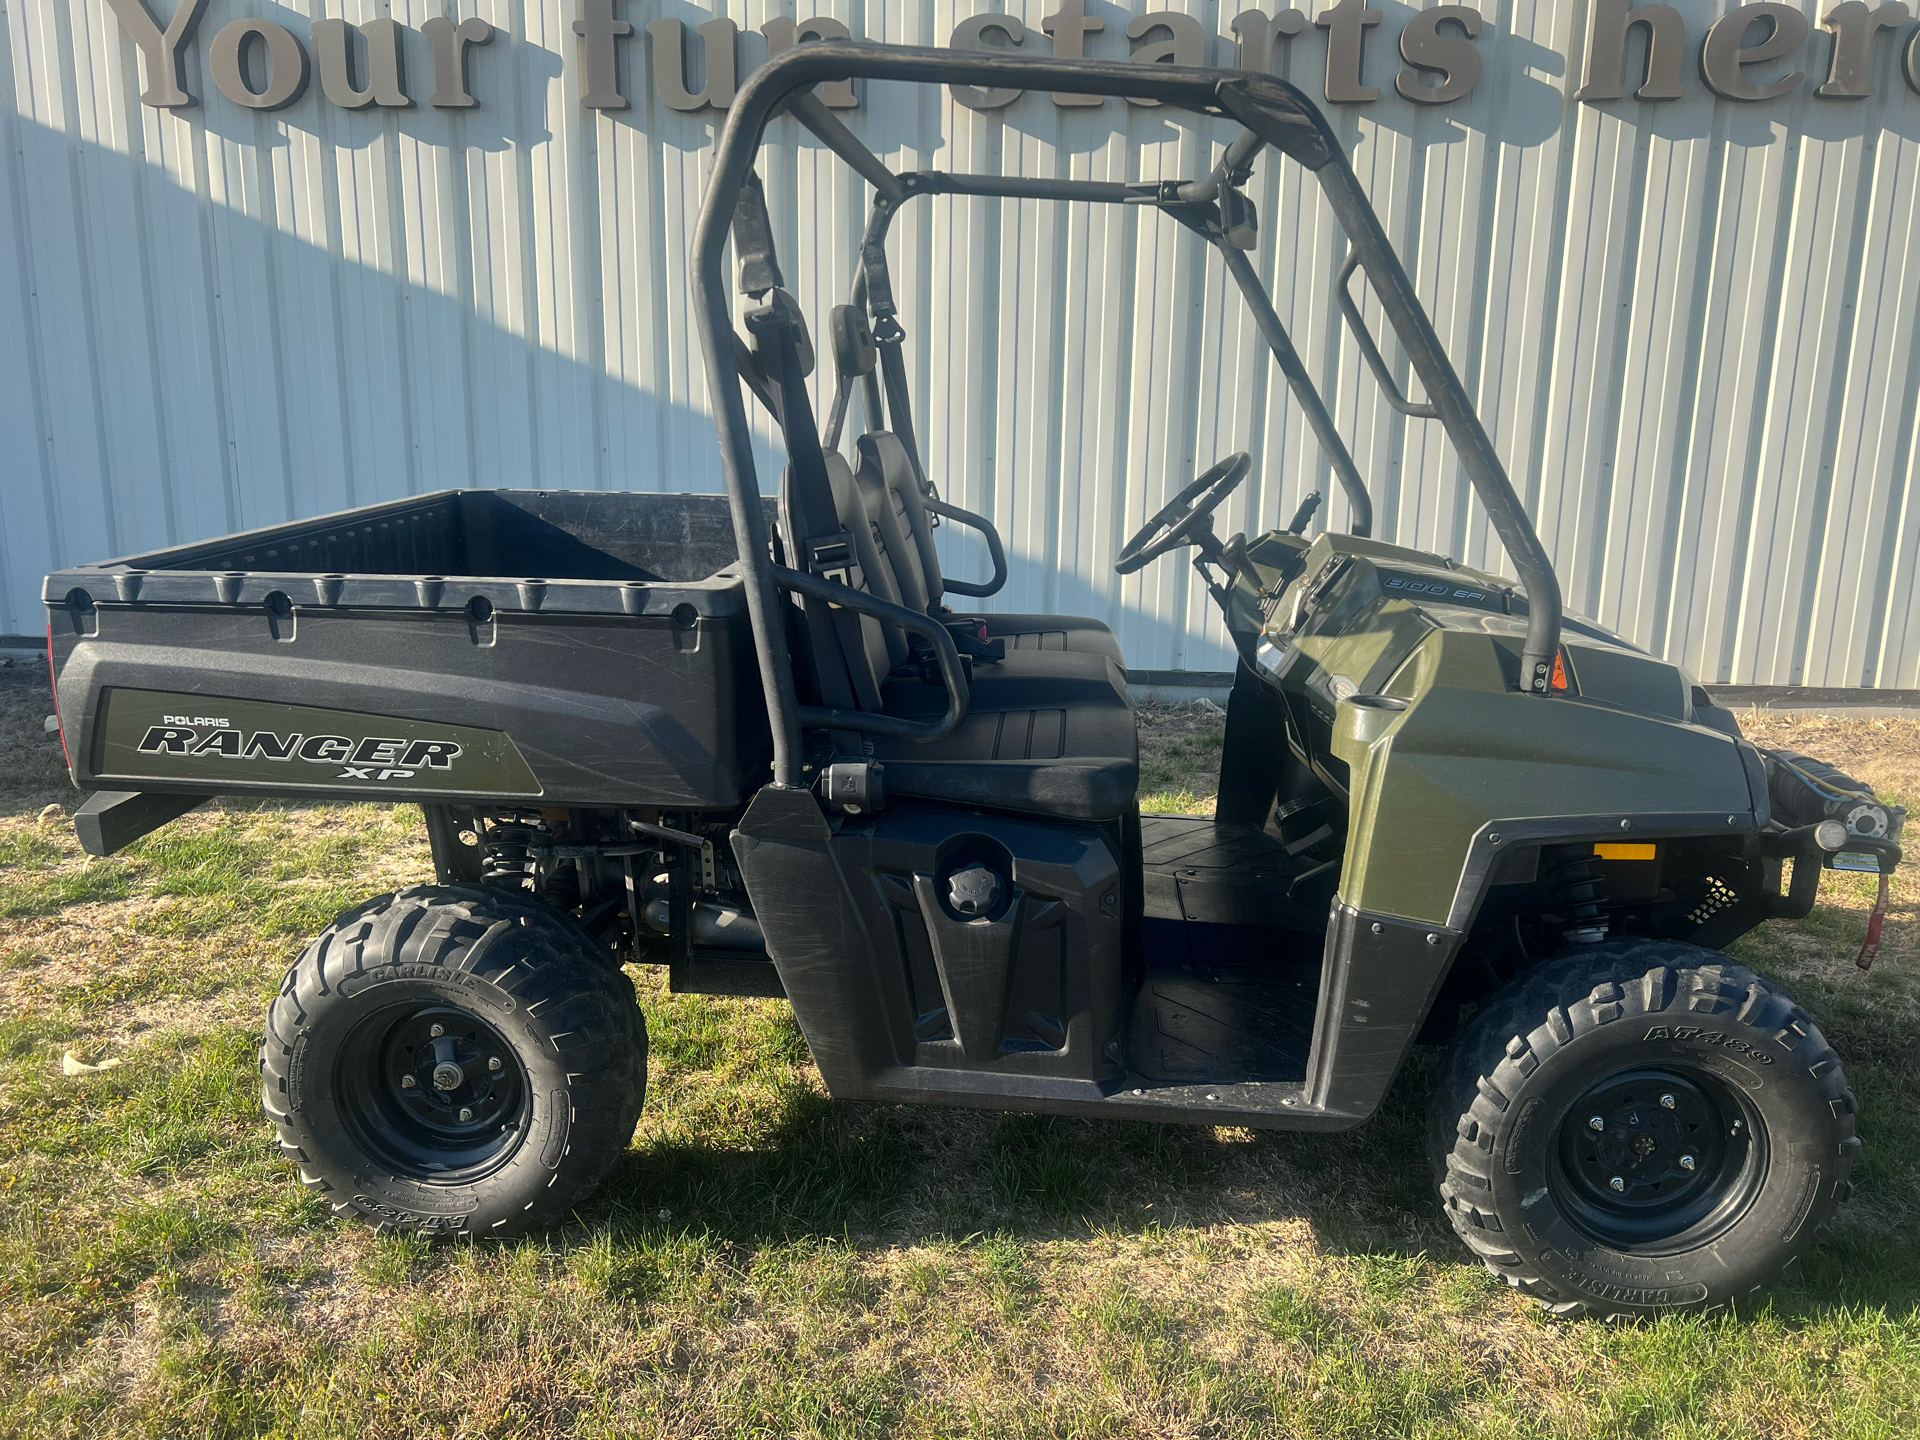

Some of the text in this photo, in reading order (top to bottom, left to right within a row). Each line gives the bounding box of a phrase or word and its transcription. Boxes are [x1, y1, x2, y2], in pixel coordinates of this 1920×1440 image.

[107, 0, 493, 110] Your
[1384, 577, 1488, 602] 800 EFI
[163, 715, 230, 728] POLARIS
[137, 726, 463, 770] RANGER
[335, 766, 415, 780] XP
[371, 964, 480, 991] CARLISLE
[1643, 1025, 1773, 1065] AT489
[1563, 1268, 1674, 1303] CARLISLE
